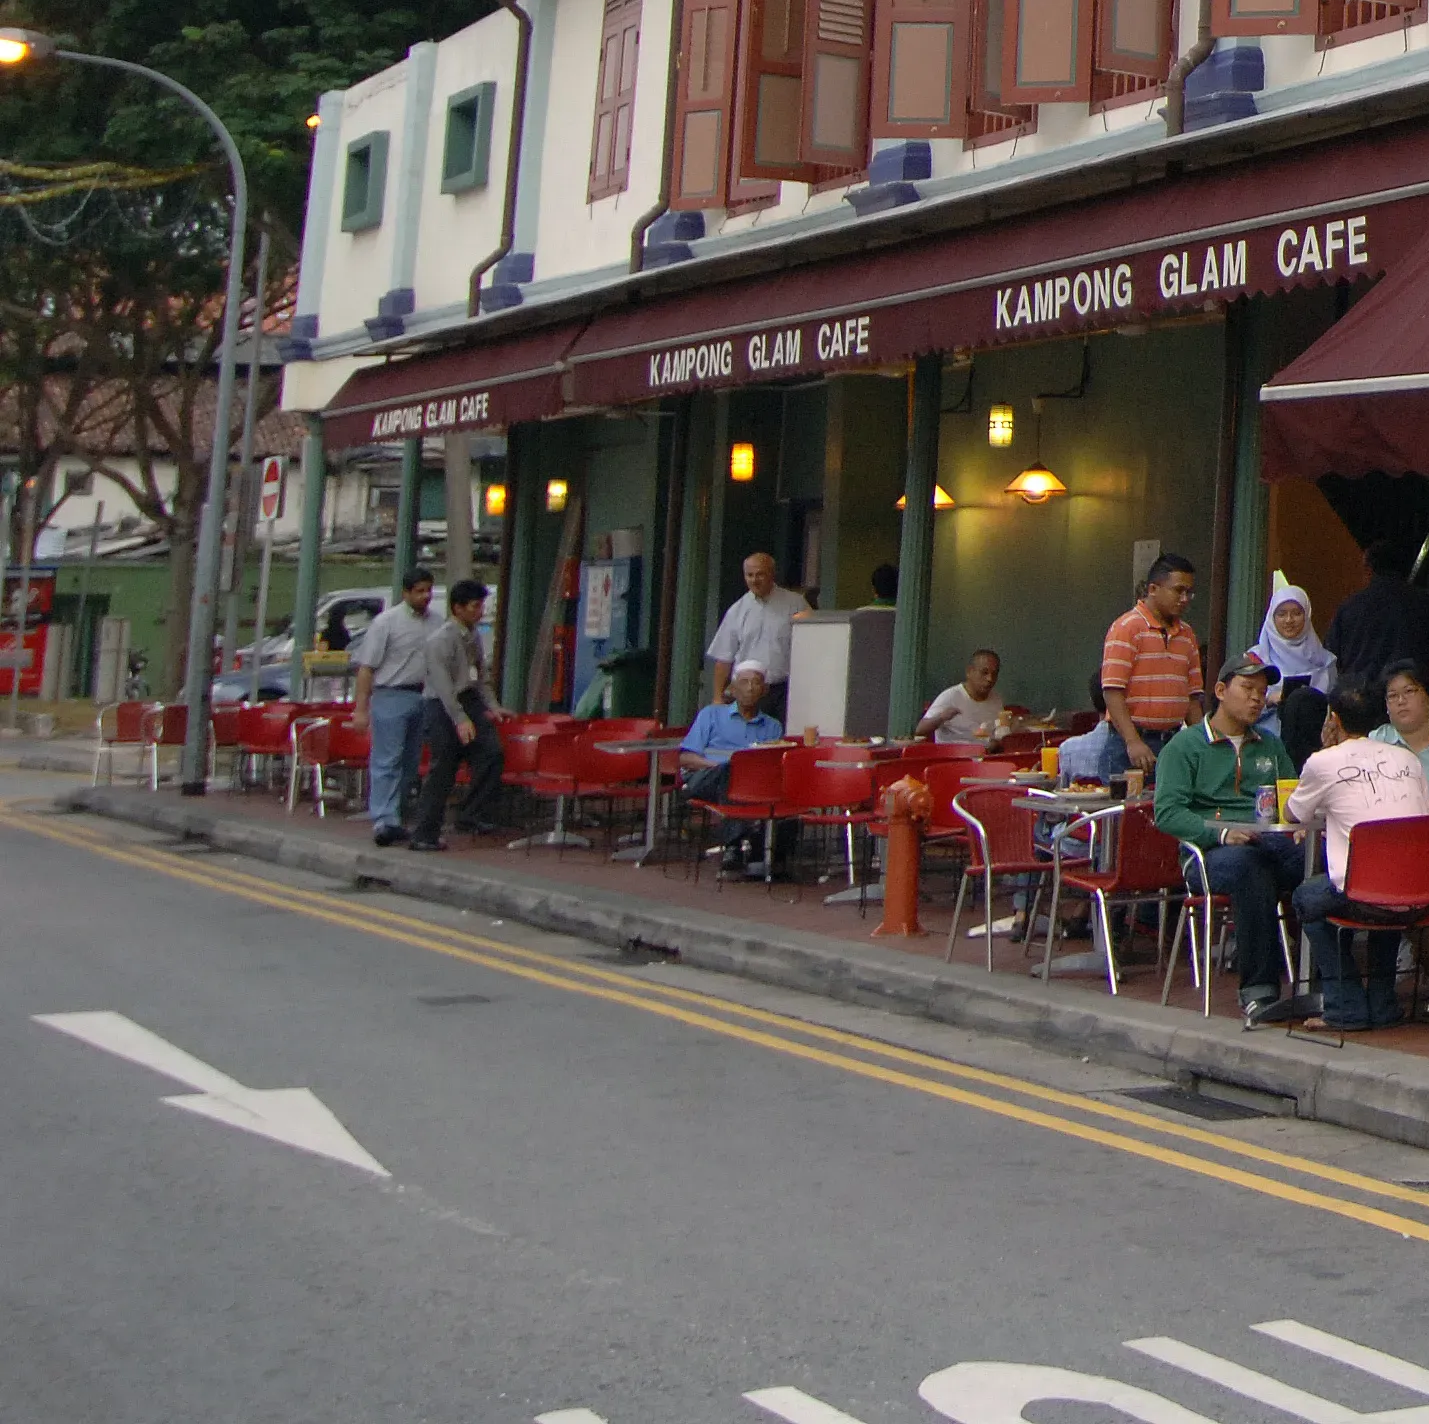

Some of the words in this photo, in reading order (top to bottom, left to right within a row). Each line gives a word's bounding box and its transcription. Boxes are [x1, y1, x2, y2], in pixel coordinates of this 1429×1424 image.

[995, 263, 1133, 329] KAMPONG
[1158, 239, 1247, 299] GLAM
[1276, 215, 1368, 277] CAFE
[649, 340, 733, 387] KAMPONG
[748, 329, 801, 371] GLAM
[817, 315, 870, 361] CAFE
[371, 404, 423, 439] KAMPONG
[426, 399, 458, 429] GLAM
[460, 391, 489, 423] CAFE
